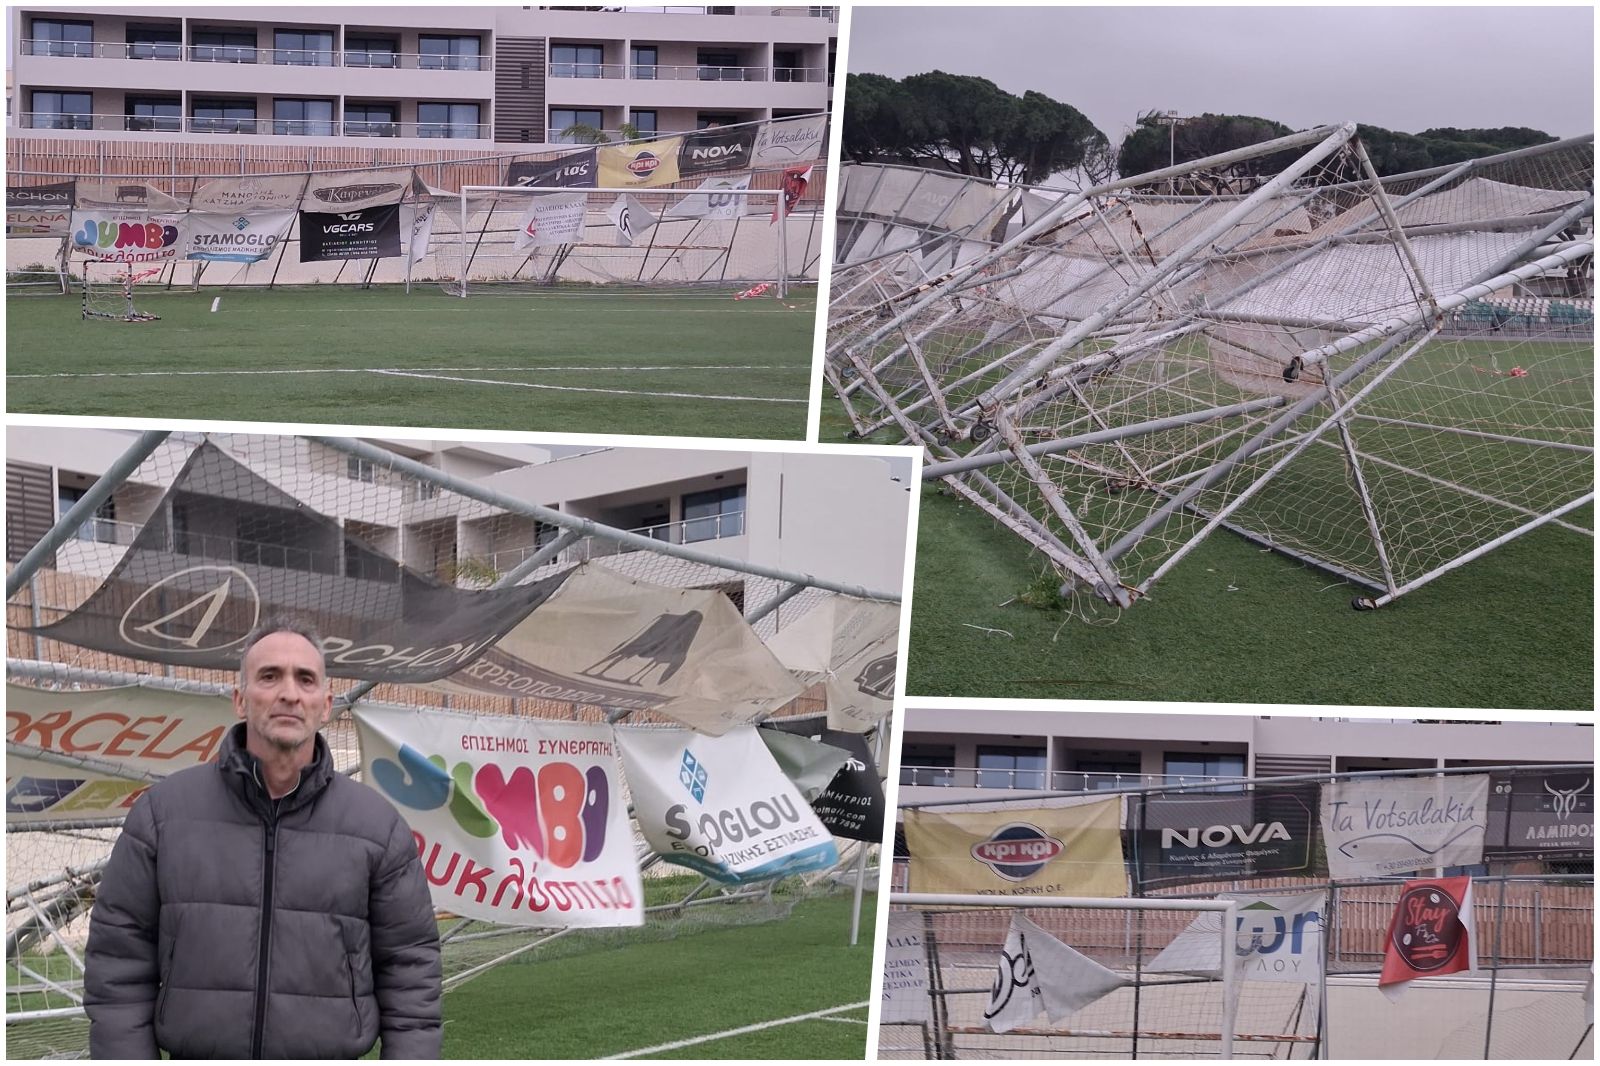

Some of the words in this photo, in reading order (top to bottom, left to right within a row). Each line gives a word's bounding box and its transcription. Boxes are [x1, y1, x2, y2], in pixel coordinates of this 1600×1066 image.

[692, 143, 742, 159] NOVA
[75, 219, 179, 249] JUMBO
[323, 223, 374, 234] VGCARS
[6, 710, 227, 763] ORCELA
[461, 735, 529, 754] ΕΠΙΣΗΜΟΣ
[538, 739, 613, 757] ΣΥΝΕΡΓΑΤΗΣ
[371, 743, 610, 869] JUMBO
[1328, 801, 1354, 833] Ta
[1364, 796, 1475, 830] Votsalakia
[1161, 821, 1292, 849] NOVA
[1406, 896, 1450, 933] Stay
